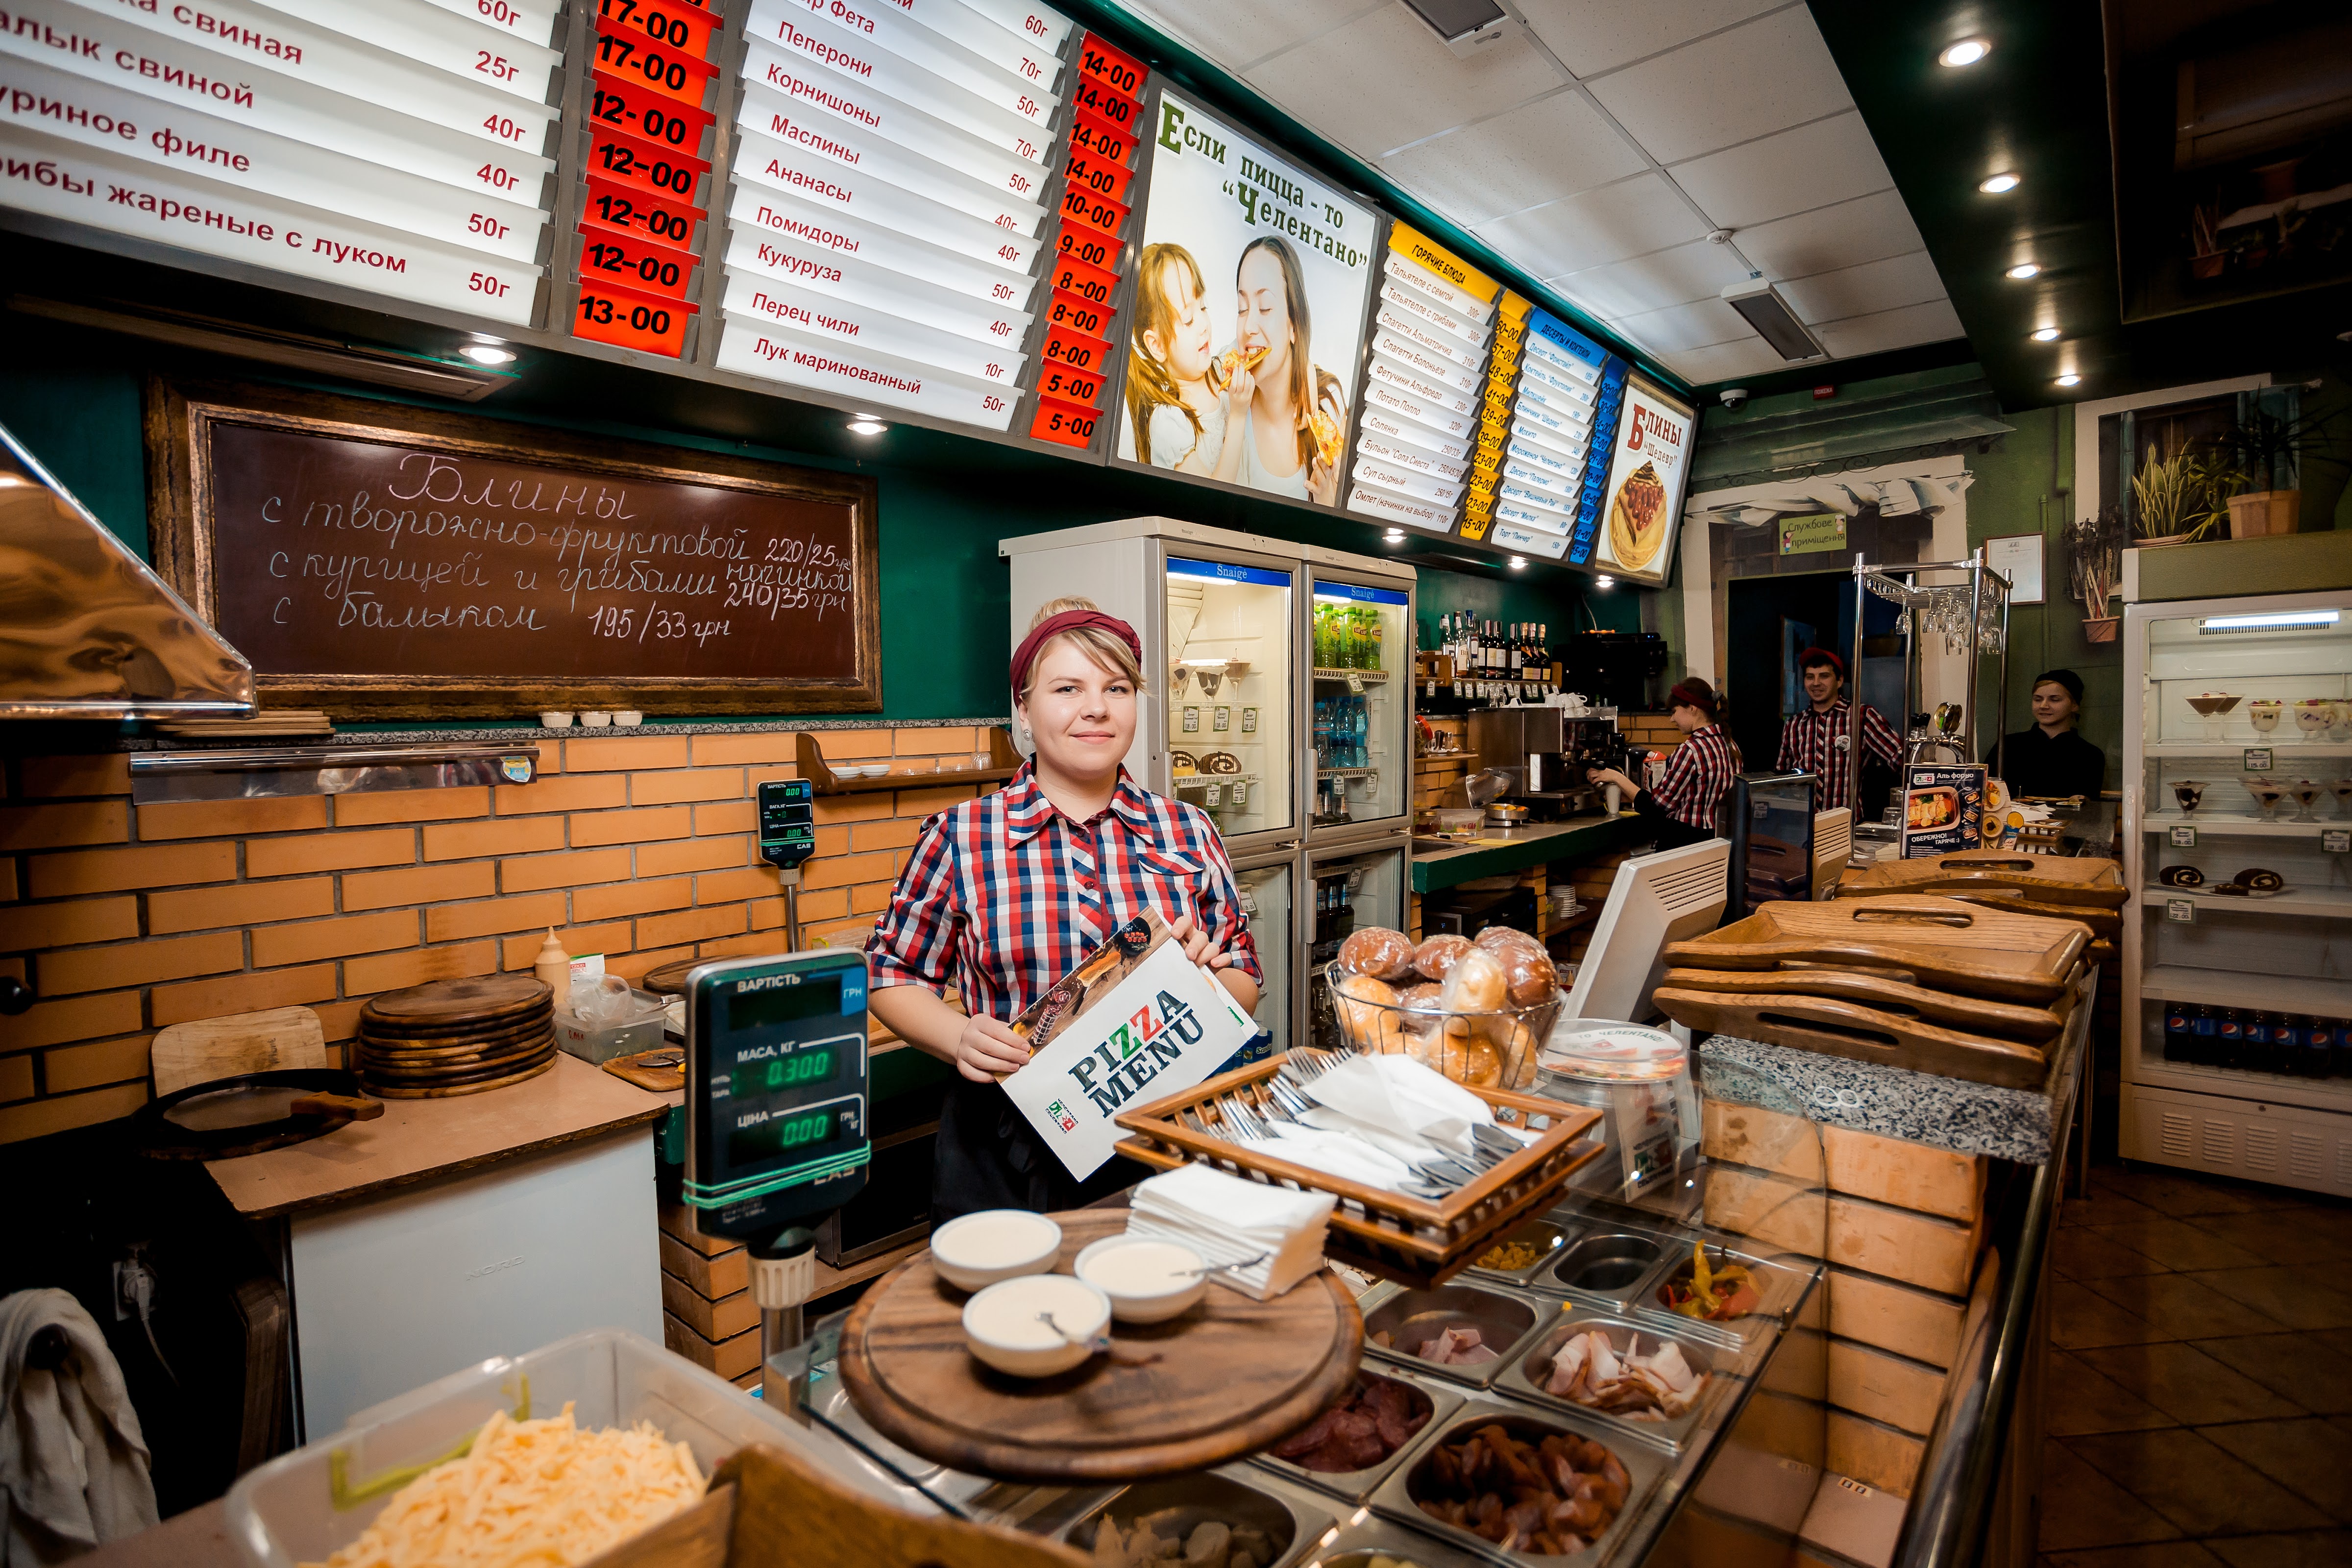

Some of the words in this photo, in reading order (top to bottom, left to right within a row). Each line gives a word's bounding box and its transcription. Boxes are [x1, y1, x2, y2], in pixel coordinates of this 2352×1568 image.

[600, 0, 688, 48] 17-00
[1024, 14, 1048, 39] 60г
[172, 3, 304, 65] свиная
[483, 114, 526, 143] 40г
[474, 50, 519, 83] 25г
[598, 34, 687, 92] 17-00
[1018, 56, 1043, 81] 70г
[1083, 50, 1136, 92] 14-00
[778, 21, 873, 78] Пеперони
[1014, 138, 1038, 160] 70г
[1016, 95, 1041, 118] 50г
[1076, 81, 1129, 123] 14-00
[114, 48, 254, 109] свиной
[476, 164, 519, 192] 40г
[766, 63, 882, 128] Корнишоны
[1008, 172, 1031, 194] 50г
[771, 115, 861, 165] Маслины
[1072, 122, 1122, 160] 14-00
[598, 144, 692, 195] 12-00
[1065, 157, 1115, 194] 14-00
[1158, 101, 1226, 164] Если
[1240, 155, 1303, 208] пицца
[1325, 203, 1343, 228] то
[151, 126, 250, 172] филе
[467, 213, 511, 240] 50г
[595, 195, 688, 243] 12-00
[765, 159, 853, 203] Ананасы
[997, 241, 1021, 262] 40г
[1065, 192, 1115, 228] 10-00
[107, 183, 275, 242] жареные
[285, 230, 302, 248] с
[312, 237, 407, 274] луком
[467, 273, 511, 298] 50г
[757, 206, 859, 253] Помидоры
[991, 282, 1015, 303] 50г
[1061, 234, 1106, 264] 9-00
[588, 243, 680, 287] 12-00
[1412, 245, 1444, 271] ГОРЯЧИЕ
[1443, 264, 1466, 285] БЛЮДА
[758, 244, 842, 283] Кукуруза
[989, 319, 1012, 340] 40г
[1059, 271, 1107, 303] 8-00
[1391, 263, 1426, 289] Тальятеле
[1431, 285, 1454, 302] семгой
[1467, 306, 1479, 319] 300г
[578, 295, 671, 335] 13-00
[1053, 304, 1099, 332] 8-00
[1387, 287, 1426, 314] Тальятелле
[1432, 311, 1457, 330] грибами
[1468, 330, 1481, 343] 300г
[1495, 320, 1519, 341] 60-00
[752, 293, 809, 325] Перец
[817, 314, 859, 337] чили
[983, 362, 1005, 382] 10г
[1382, 313, 1416, 335] Спагетти
[1462, 356, 1476, 368] 310г
[1541, 324, 1565, 343] ДЕСЕРТЫ
[1046, 340, 1091, 368] 8-00
[1383, 339, 1413, 361] Спагетти
[1413, 352, 1446, 376] Болоньезе
[1459, 377, 1472, 390] 310г
[1492, 343, 1515, 362] 57-00
[754, 338, 789, 364] Лук
[793, 350, 922, 395] маринованный
[982, 395, 1005, 415] 50г
[1047, 374, 1094, 400] 5-00
[1376, 366, 1410, 387] Фетучини
[1410, 379, 1442, 400] Альфредо
[1454, 401, 1468, 412] 230г
[1376, 390, 1399, 407] Потато
[1400, 400, 1421, 416] Полло
[1448, 420, 1462, 432] 320г
[1486, 389, 1508, 407] 41-00
[1050, 414, 1094, 439] 5-00
[1370, 417, 1398, 435] Солянка
[1479, 432, 1500, 447] 39-00
[1518, 426, 1537, 439] Мохито
[1628, 404, 1682, 450] Блины
[1364, 440, 1390, 456] Бульон
[1474, 452, 1495, 468] 23-00
[389, 453, 637, 519] Блины
[1363, 466, 1377, 478] Суп
[1378, 472, 1406, 486] сырный
[1470, 475, 1493, 490] 23-00
[262, 497, 281, 522] с
[1355, 490, 1377, 504] Омлет
[1466, 497, 1488, 512] 23-00
[1462, 517, 1485, 531] 15-00
[1499, 529, 1511, 538] Торт
[1788, 518, 1832, 533] Службове
[1792, 534, 1845, 548] приміщення
[270, 551, 288, 577] с
[303, 552, 490, 599] курицей
[514, 570, 539, 590] и
[558, 560, 717, 613] грибами
[726, 564, 851, 592] начинкой
[1217, 564, 1247, 580] Snaigė
[273, 597, 291, 623] с
[338, 591, 547, 630] балыком
[691, 620, 732, 648] грн
[811, 593, 846, 622] грн
[1911, 833, 1947, 842] ОБЕРЕЖНО!
[737, 974, 801, 993] ВАРТІСТЬ
[843, 987, 862, 999] ГРН
[737, 1046, 778, 1062] МАСА,
[781, 1041, 795, 1054] КГ
[1068, 990, 1188, 1093] PIZZA
[1088, 1008, 1203, 1118] MENU
[738, 1110, 769, 1127] ЦІНА
